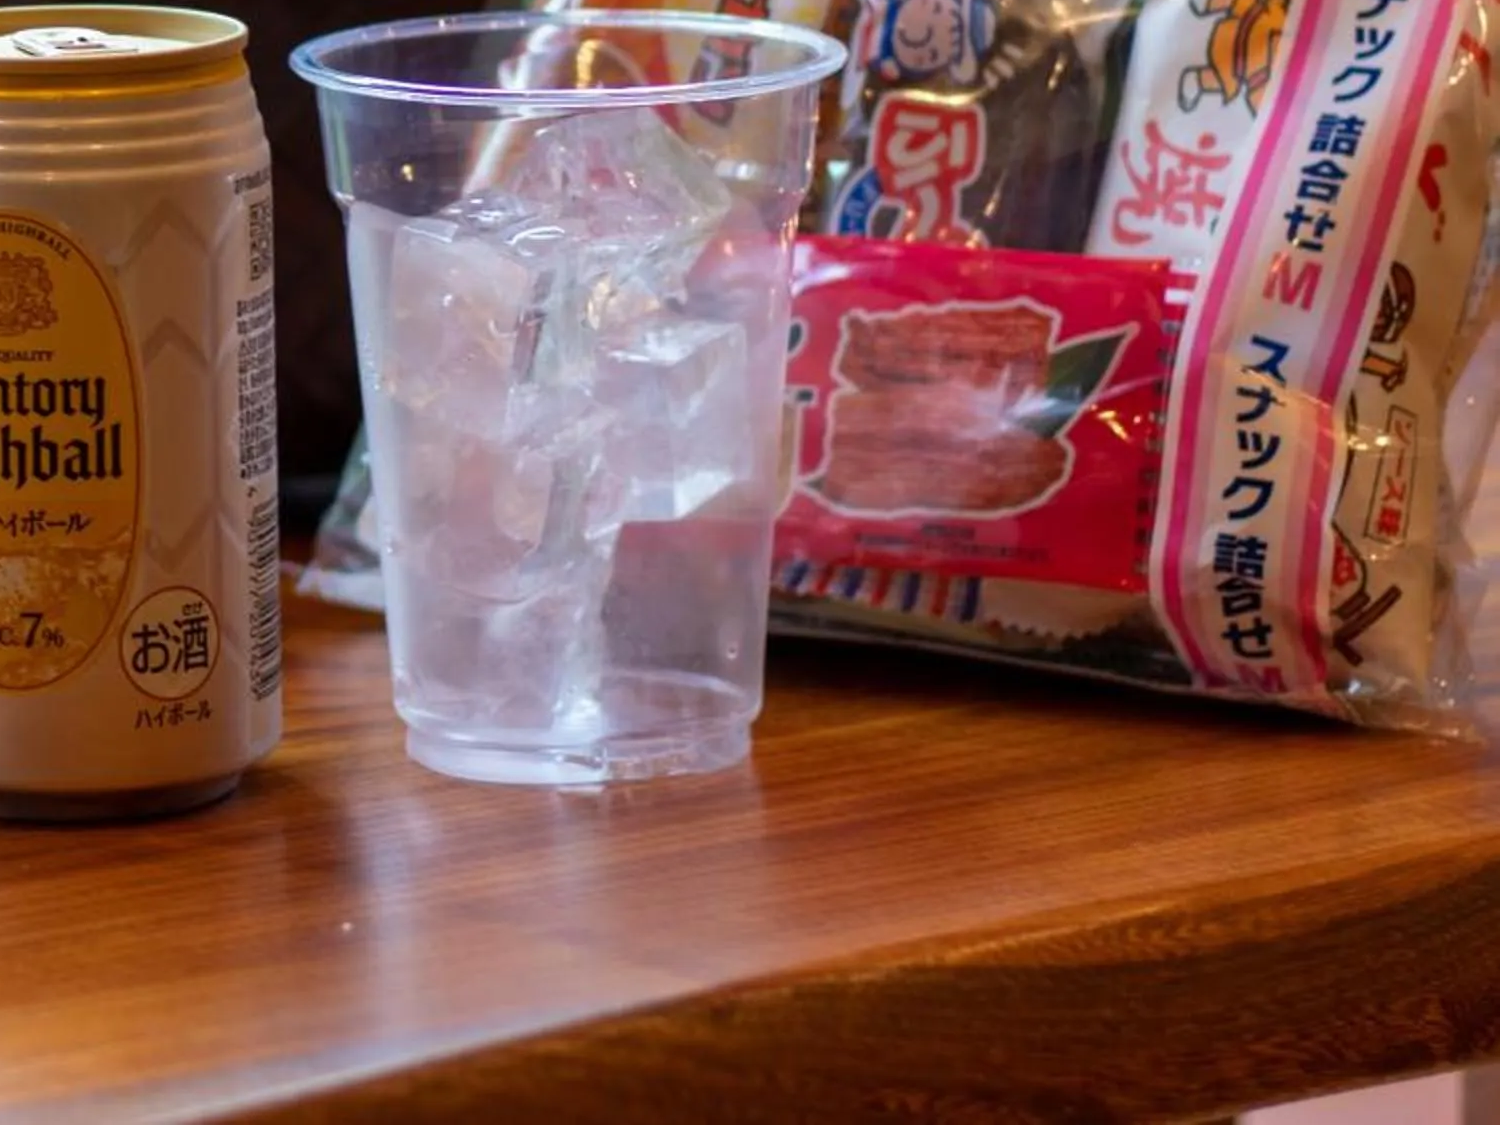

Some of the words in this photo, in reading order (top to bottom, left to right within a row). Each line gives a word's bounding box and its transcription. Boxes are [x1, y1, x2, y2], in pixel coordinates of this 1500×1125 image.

[131, 611, 211, 675] お酒
[134, 700, 214, 729] ハイボール
